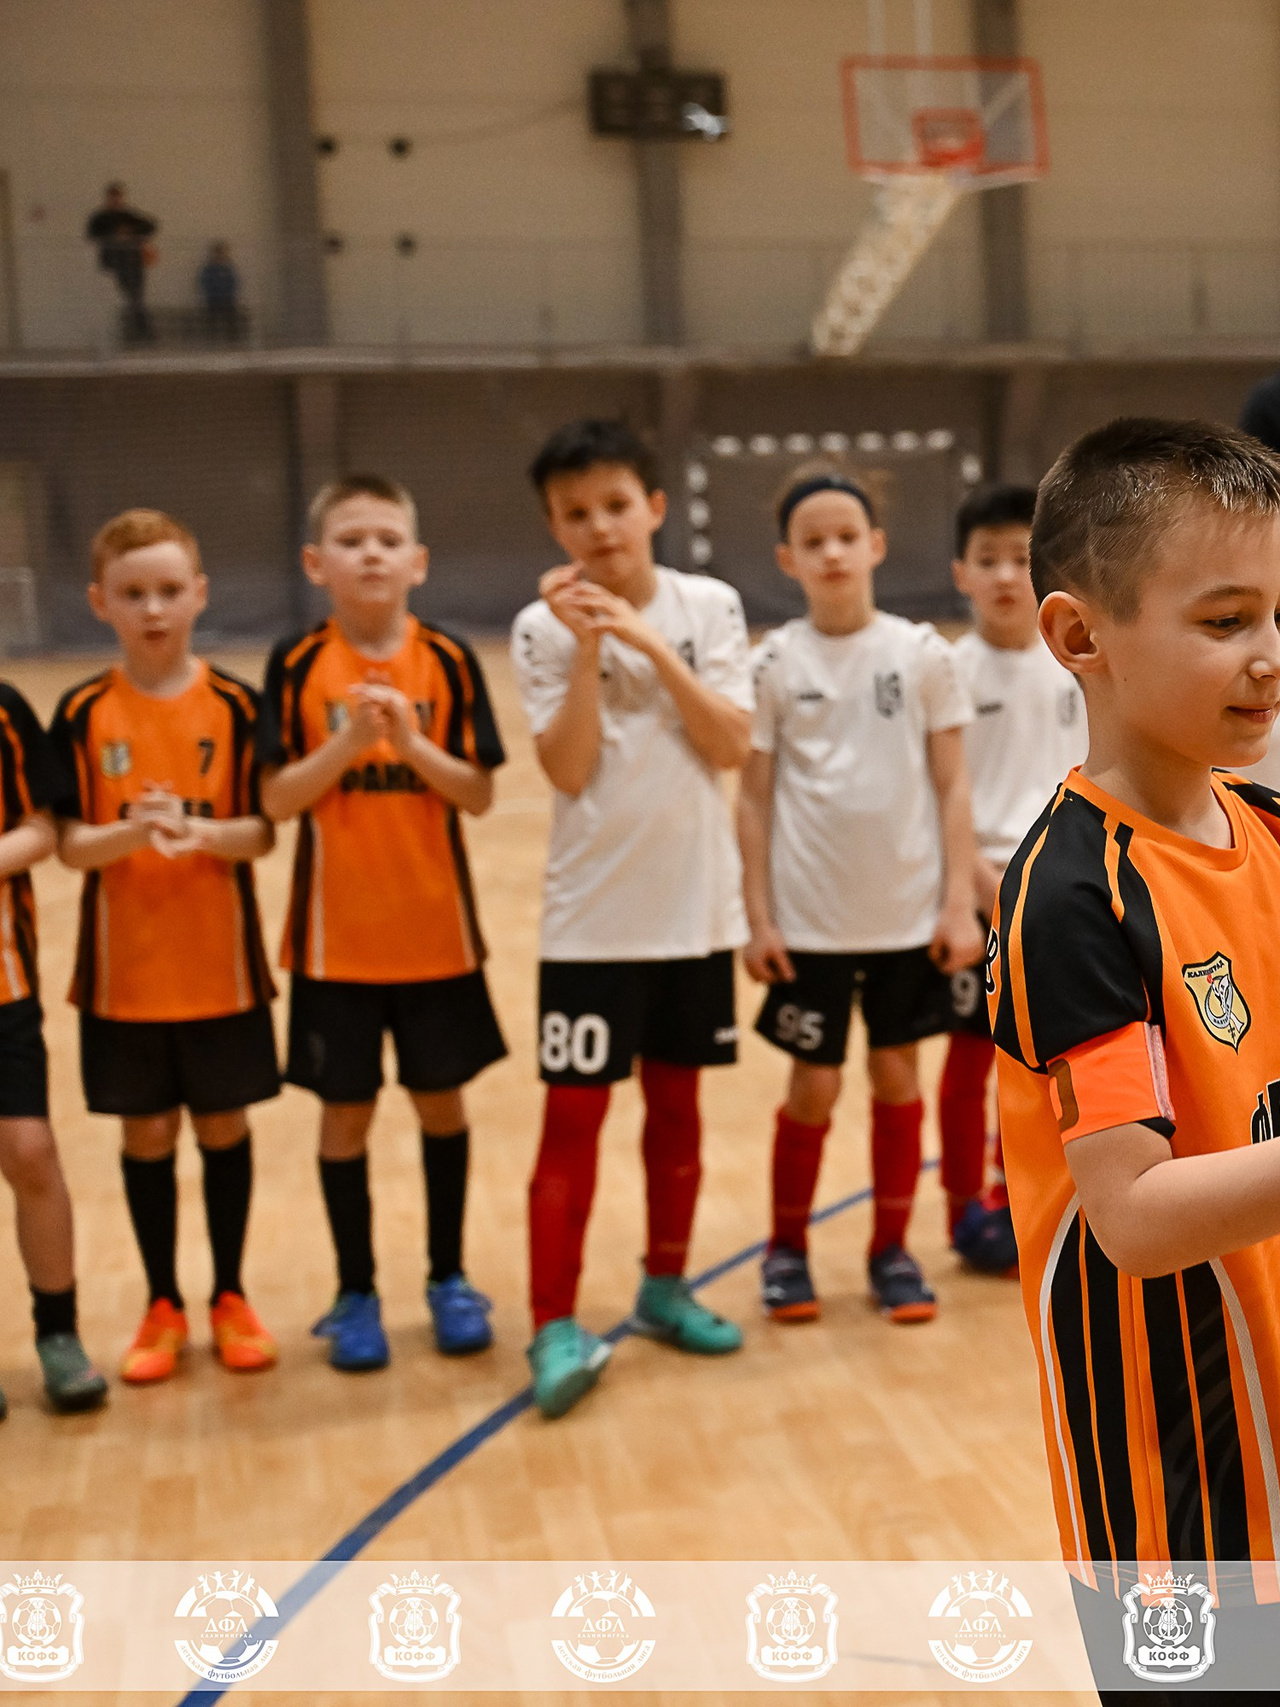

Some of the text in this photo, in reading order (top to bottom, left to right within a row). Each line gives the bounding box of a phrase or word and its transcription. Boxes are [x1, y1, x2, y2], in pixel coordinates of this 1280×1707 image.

[198, 738, 215, 776] 7
[540, 1010, 610, 1075] 80
[774, 1003, 825, 1051] 95
